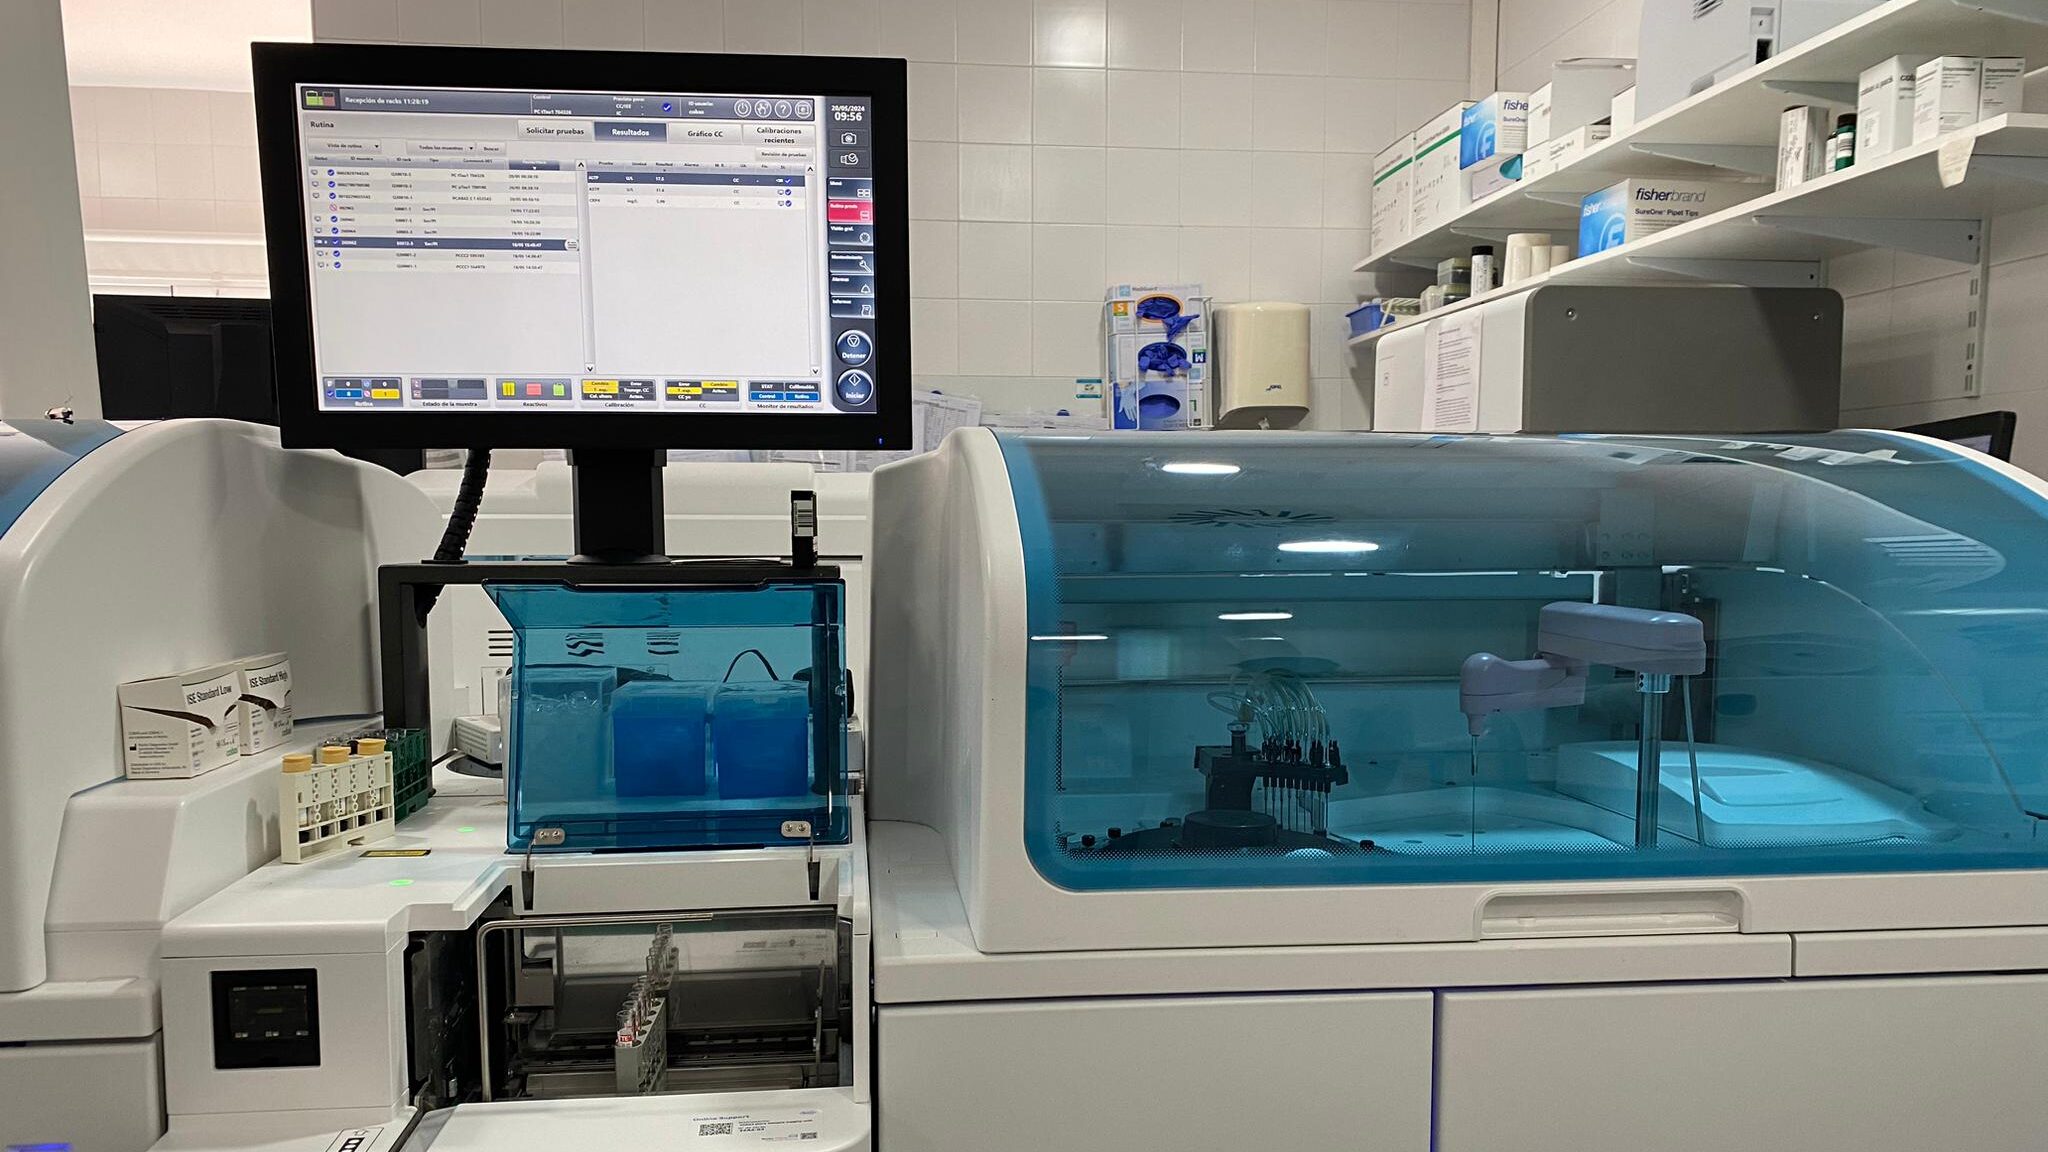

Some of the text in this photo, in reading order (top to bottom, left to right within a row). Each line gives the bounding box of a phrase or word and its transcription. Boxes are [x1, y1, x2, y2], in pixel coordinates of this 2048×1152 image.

[834, 112, 862, 121] 09:56
[556, 128, 584, 136] pruebas
[612, 128, 650, 136] Resultados
[1635, 187, 1706, 203] fisherbrand
[1666, 208, 1684, 217] Pipet
[1685, 209, 1699, 217] Tips
[250, 677, 258, 688] ISE
[258, 674, 280, 688] Standard
[186, 684, 232, 706] ISE Standard Low
